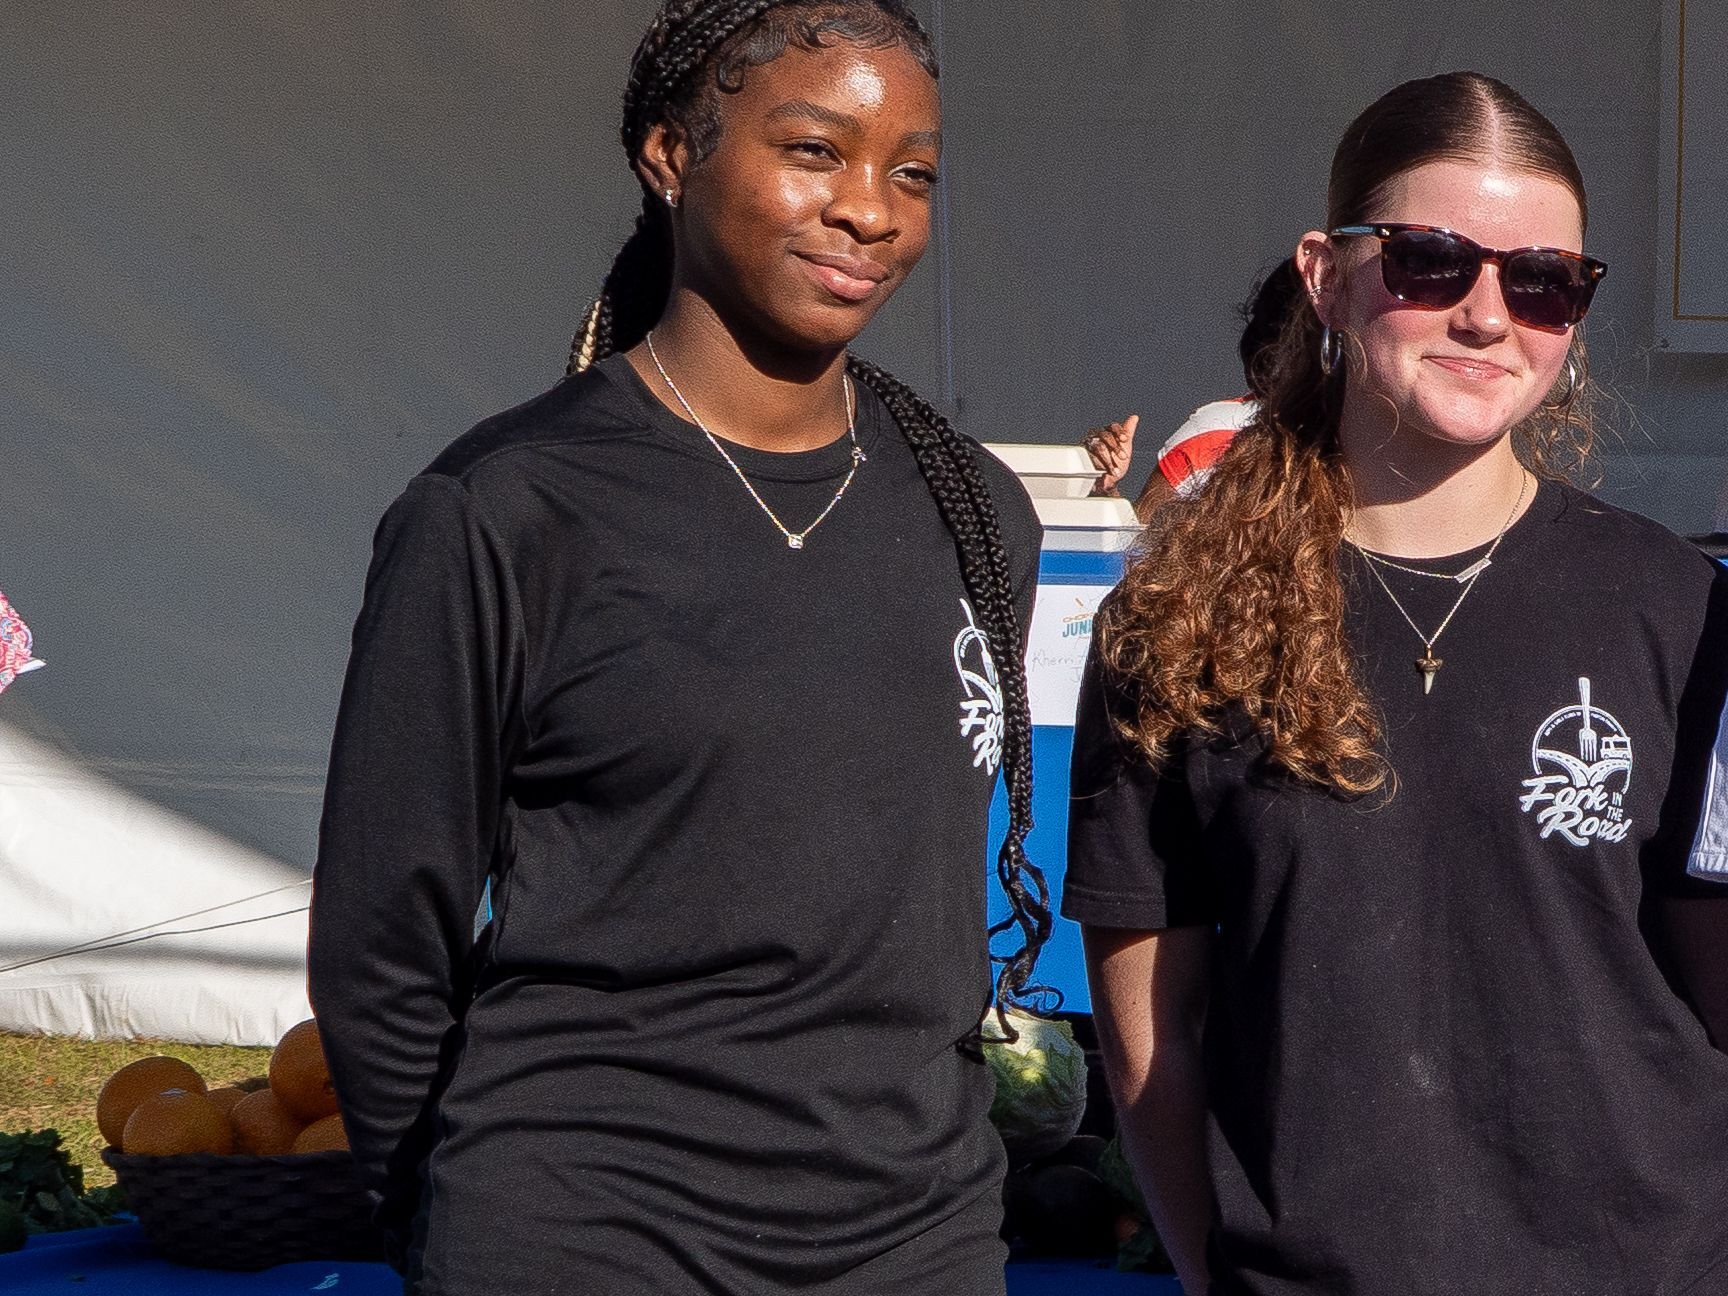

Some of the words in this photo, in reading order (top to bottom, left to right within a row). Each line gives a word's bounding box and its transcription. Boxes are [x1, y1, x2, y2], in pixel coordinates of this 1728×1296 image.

[1519, 775, 1609, 812] Fork
[1612, 792, 1623, 807] IN
[1537, 806, 1633, 847] Road
[1606, 806, 1624, 822] THE
